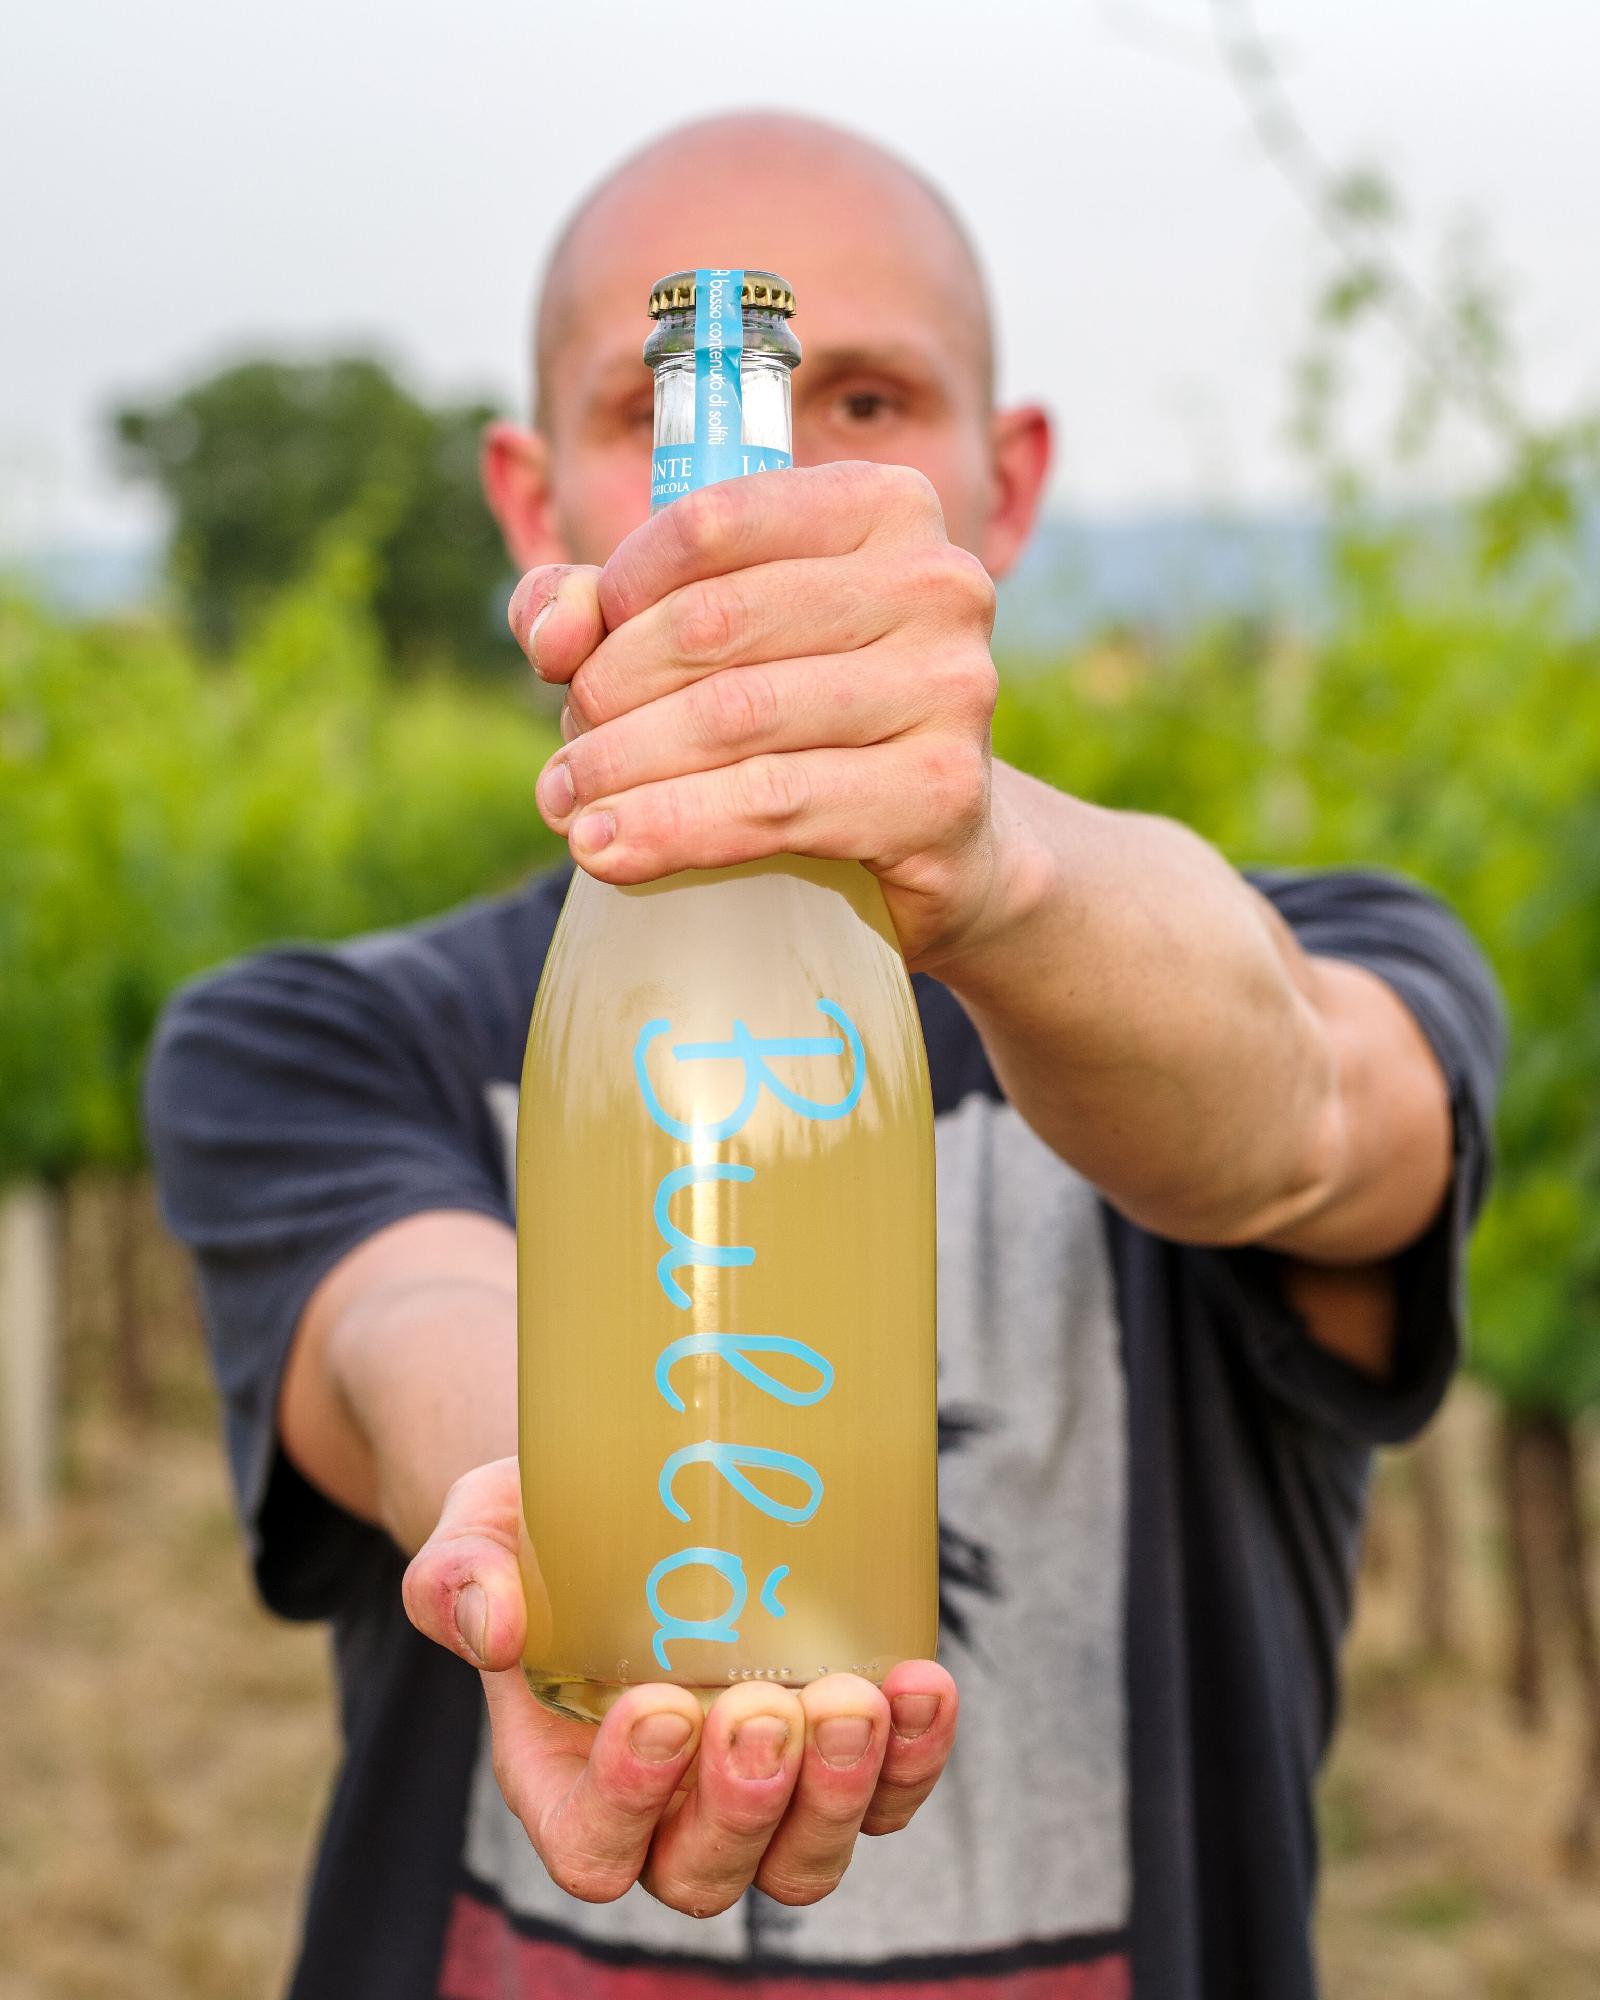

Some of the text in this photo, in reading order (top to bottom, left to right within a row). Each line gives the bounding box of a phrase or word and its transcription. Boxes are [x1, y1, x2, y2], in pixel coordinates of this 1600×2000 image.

[709, 279, 730, 319] basso
[707, 322, 726, 391] contenuto
[708, 393, 729, 407] di
[708, 410, 729, 446] solfiti
